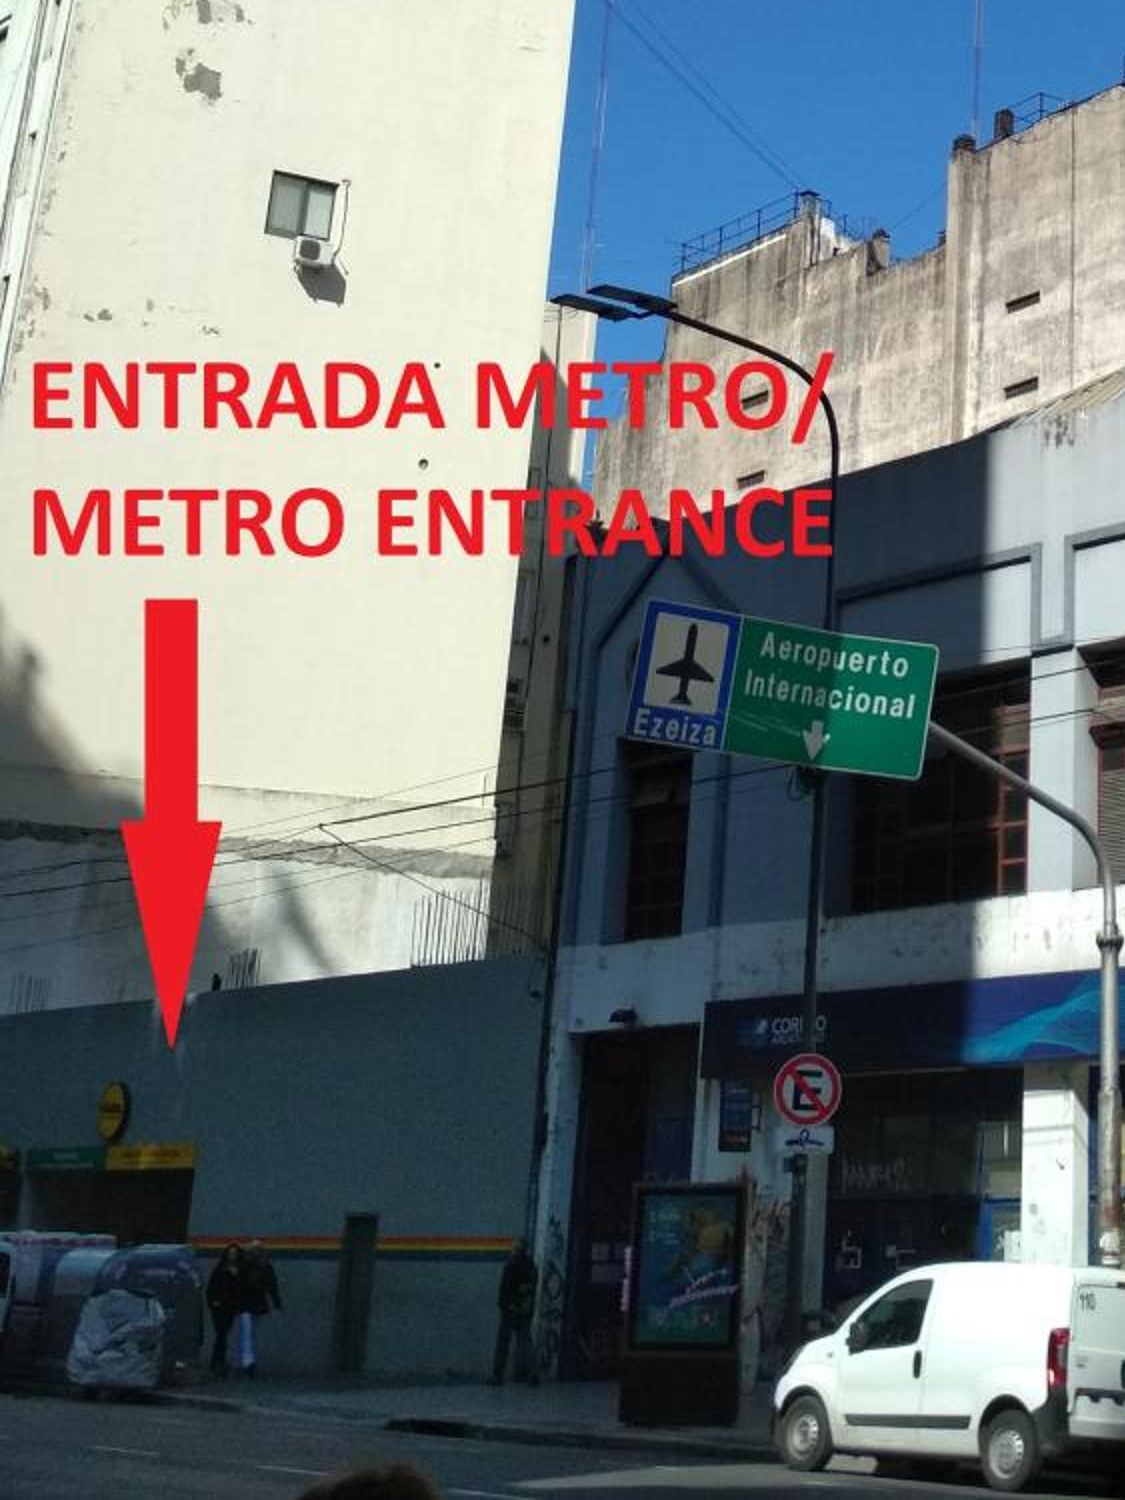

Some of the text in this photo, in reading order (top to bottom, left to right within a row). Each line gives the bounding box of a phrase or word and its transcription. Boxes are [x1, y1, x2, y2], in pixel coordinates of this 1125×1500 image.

[760, 632, 909, 677] Aeropuerto
[745, 670, 916, 719] Internacional
[632, 708, 717, 746] Ezeiza
[771, 1015, 827, 1036] CORO
